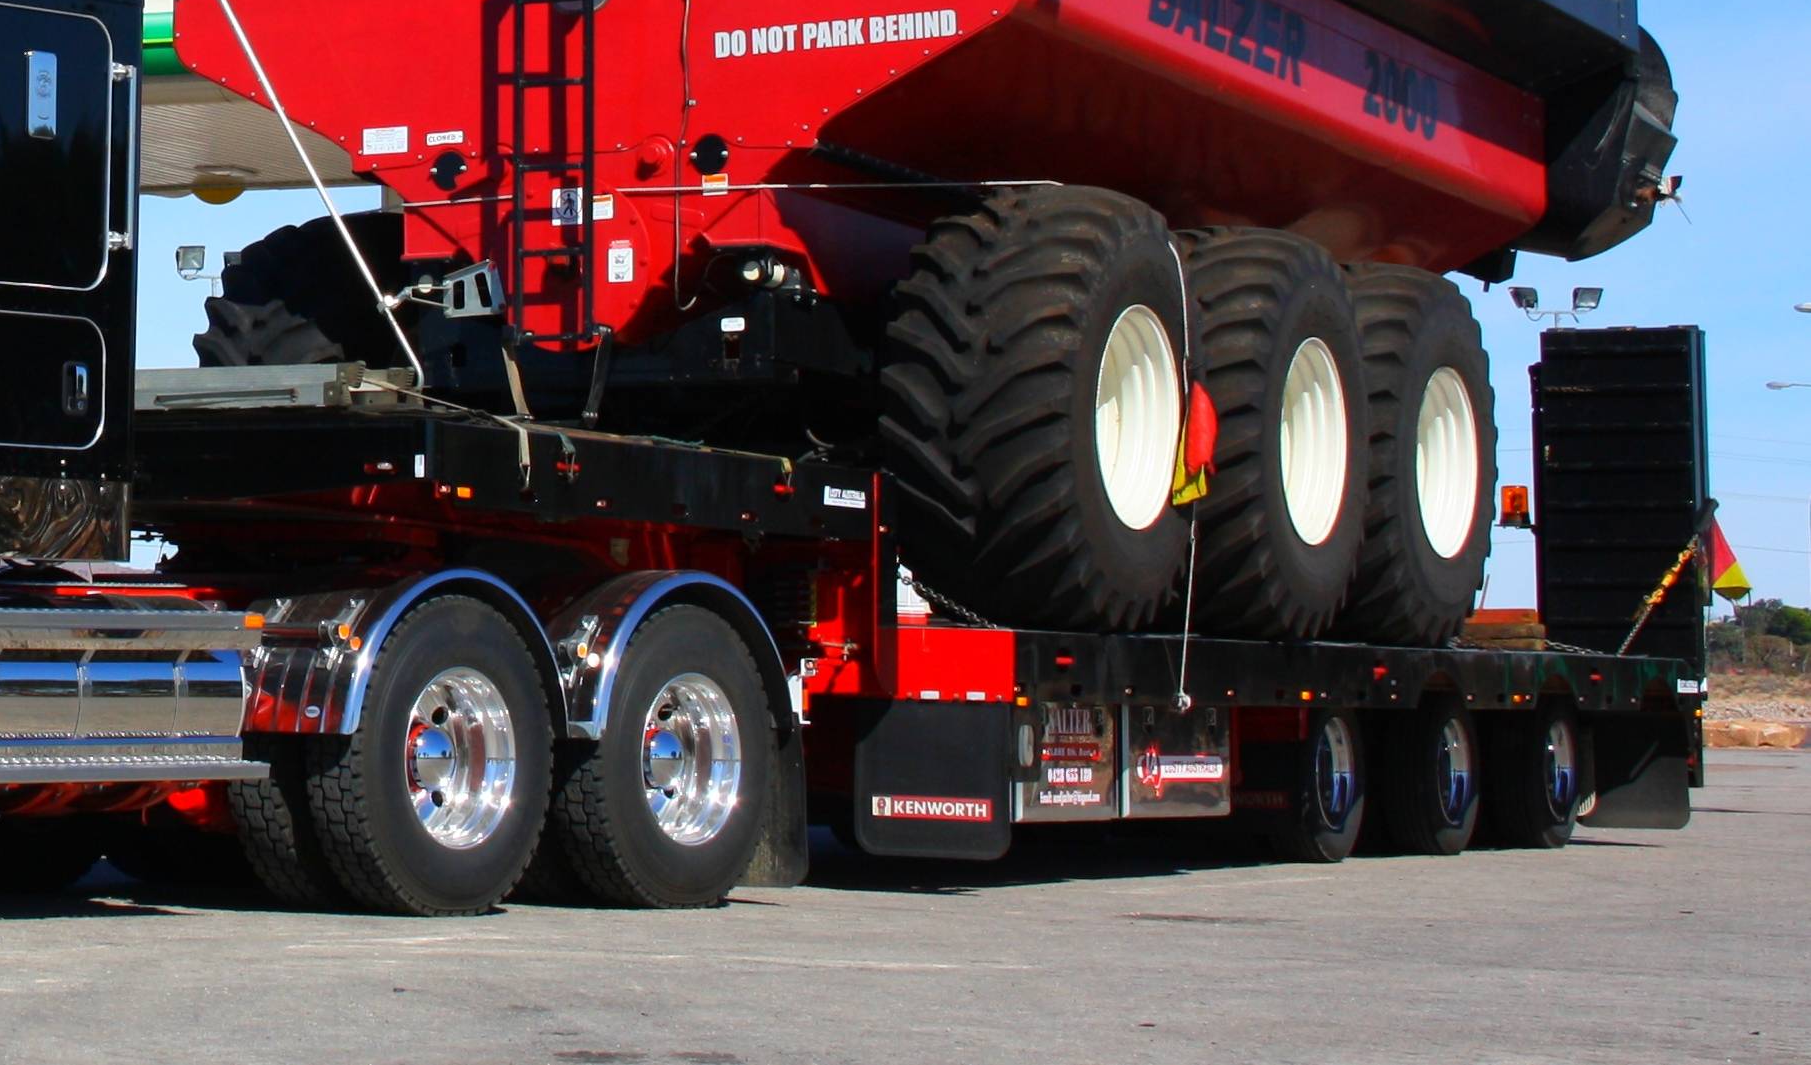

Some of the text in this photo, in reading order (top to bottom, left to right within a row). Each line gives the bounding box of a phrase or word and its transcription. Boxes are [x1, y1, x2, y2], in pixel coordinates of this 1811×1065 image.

[714, 9, 957, 58] DO NOT PARK BEHIND
[1363, 49, 1439, 141] 2000
[893, 800, 987, 818] KENWORTH
